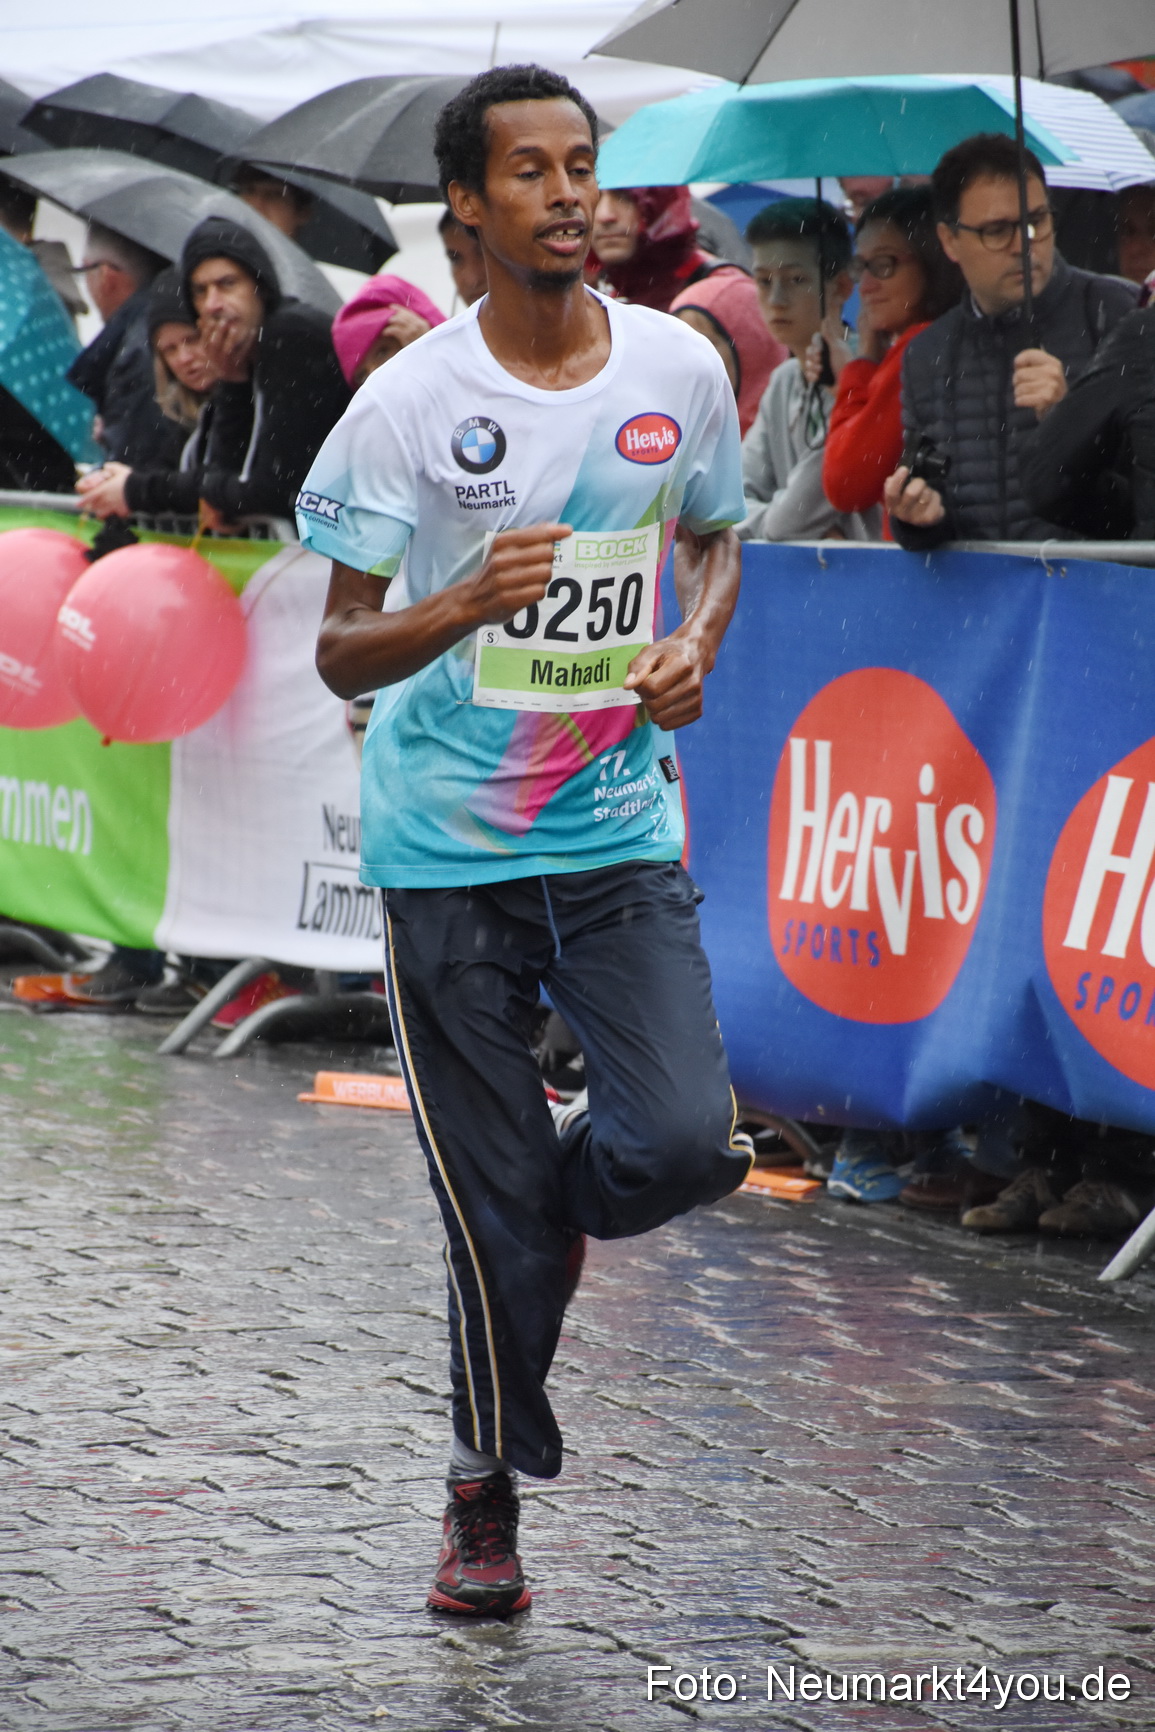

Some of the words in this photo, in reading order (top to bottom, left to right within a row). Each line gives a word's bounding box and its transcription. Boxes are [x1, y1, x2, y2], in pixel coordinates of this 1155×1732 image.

[453, 417, 500, 440] BMW
[625, 426, 675, 451] Hervis
[455, 480, 515, 500] PARTL
[458, 496, 516, 511] Neumarkt
[295, 490, 344, 523] CK
[576, 534, 649, 561] BOCK
[530, 657, 611, 688] Mahadi
[322, 803, 362, 854] Neu
[779, 738, 985, 956] Hervis
[781, 919, 881, 967] SPORTS
